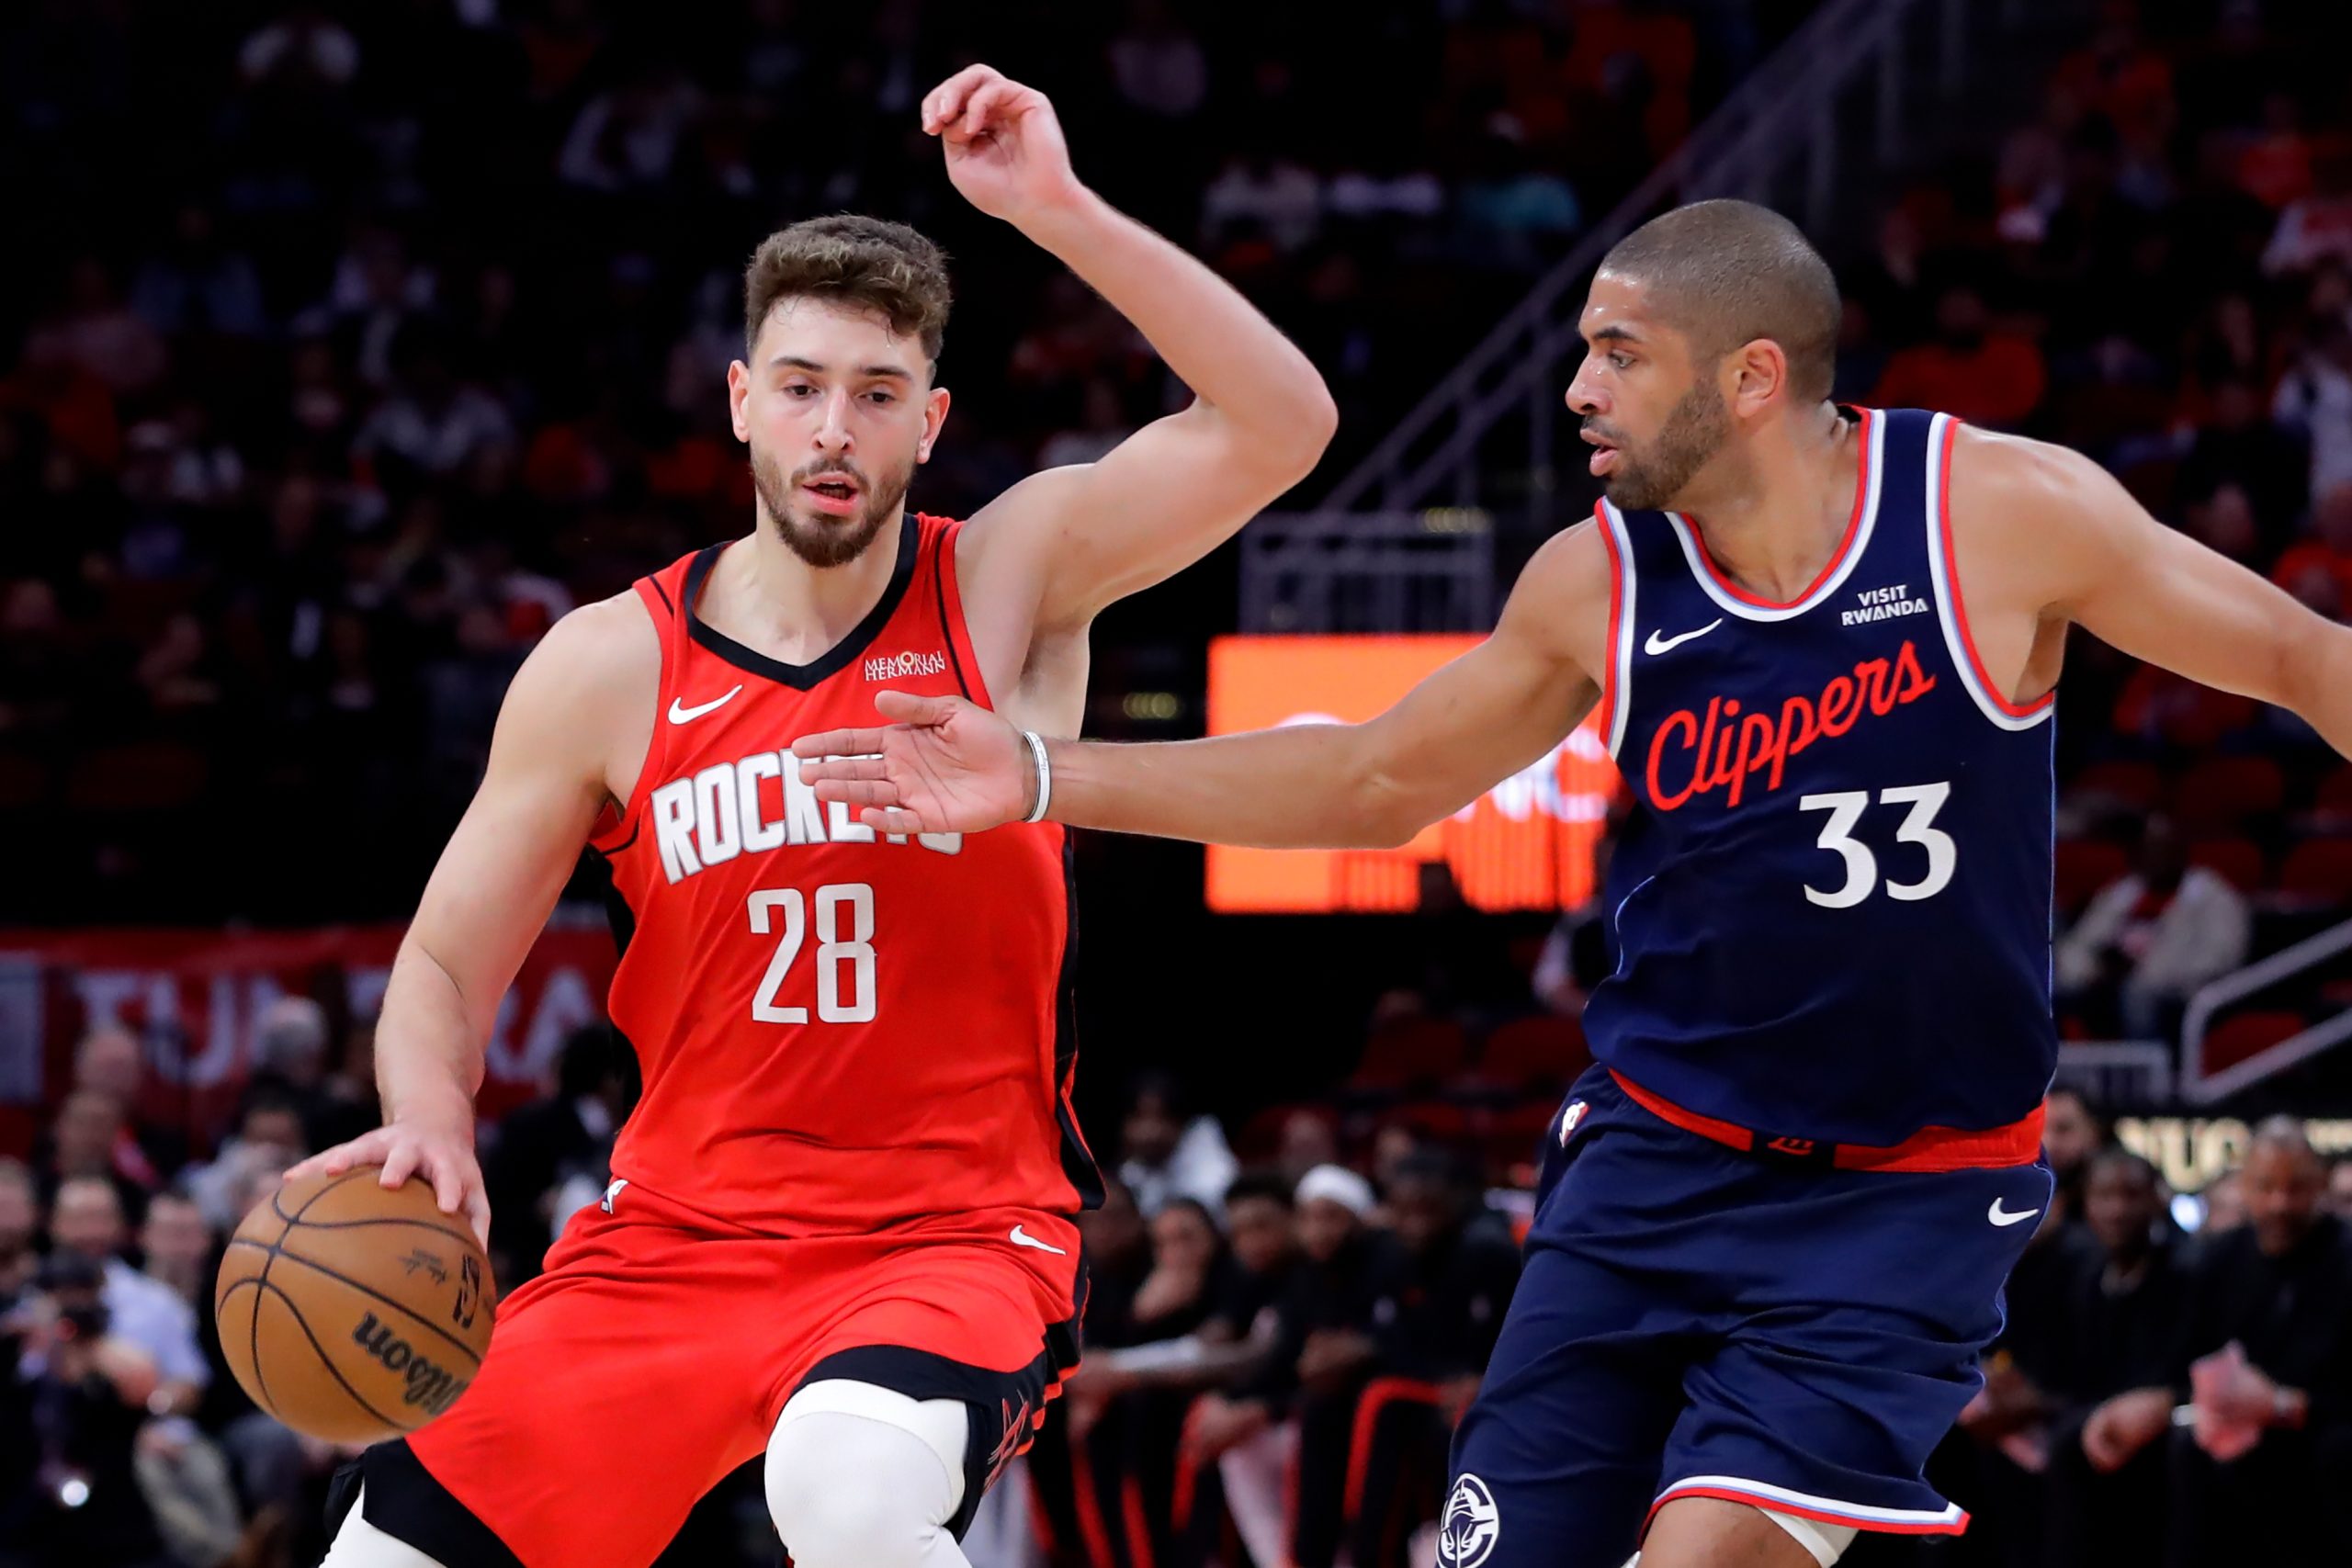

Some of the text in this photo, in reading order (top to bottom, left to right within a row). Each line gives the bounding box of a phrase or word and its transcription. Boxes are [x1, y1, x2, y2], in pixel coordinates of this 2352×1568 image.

[1841, 598, 1928, 626] RWANDA
[1857, 584, 1907, 607] VISIT
[865, 650, 944, 671] MEMORIAL
[865, 659, 945, 682] HERMANN
[1645, 640, 1937, 810] Clippers
[650, 748, 963, 885] ROCK
[1799, 781, 1957, 908] 33
[746, 883, 876, 1024] 28
